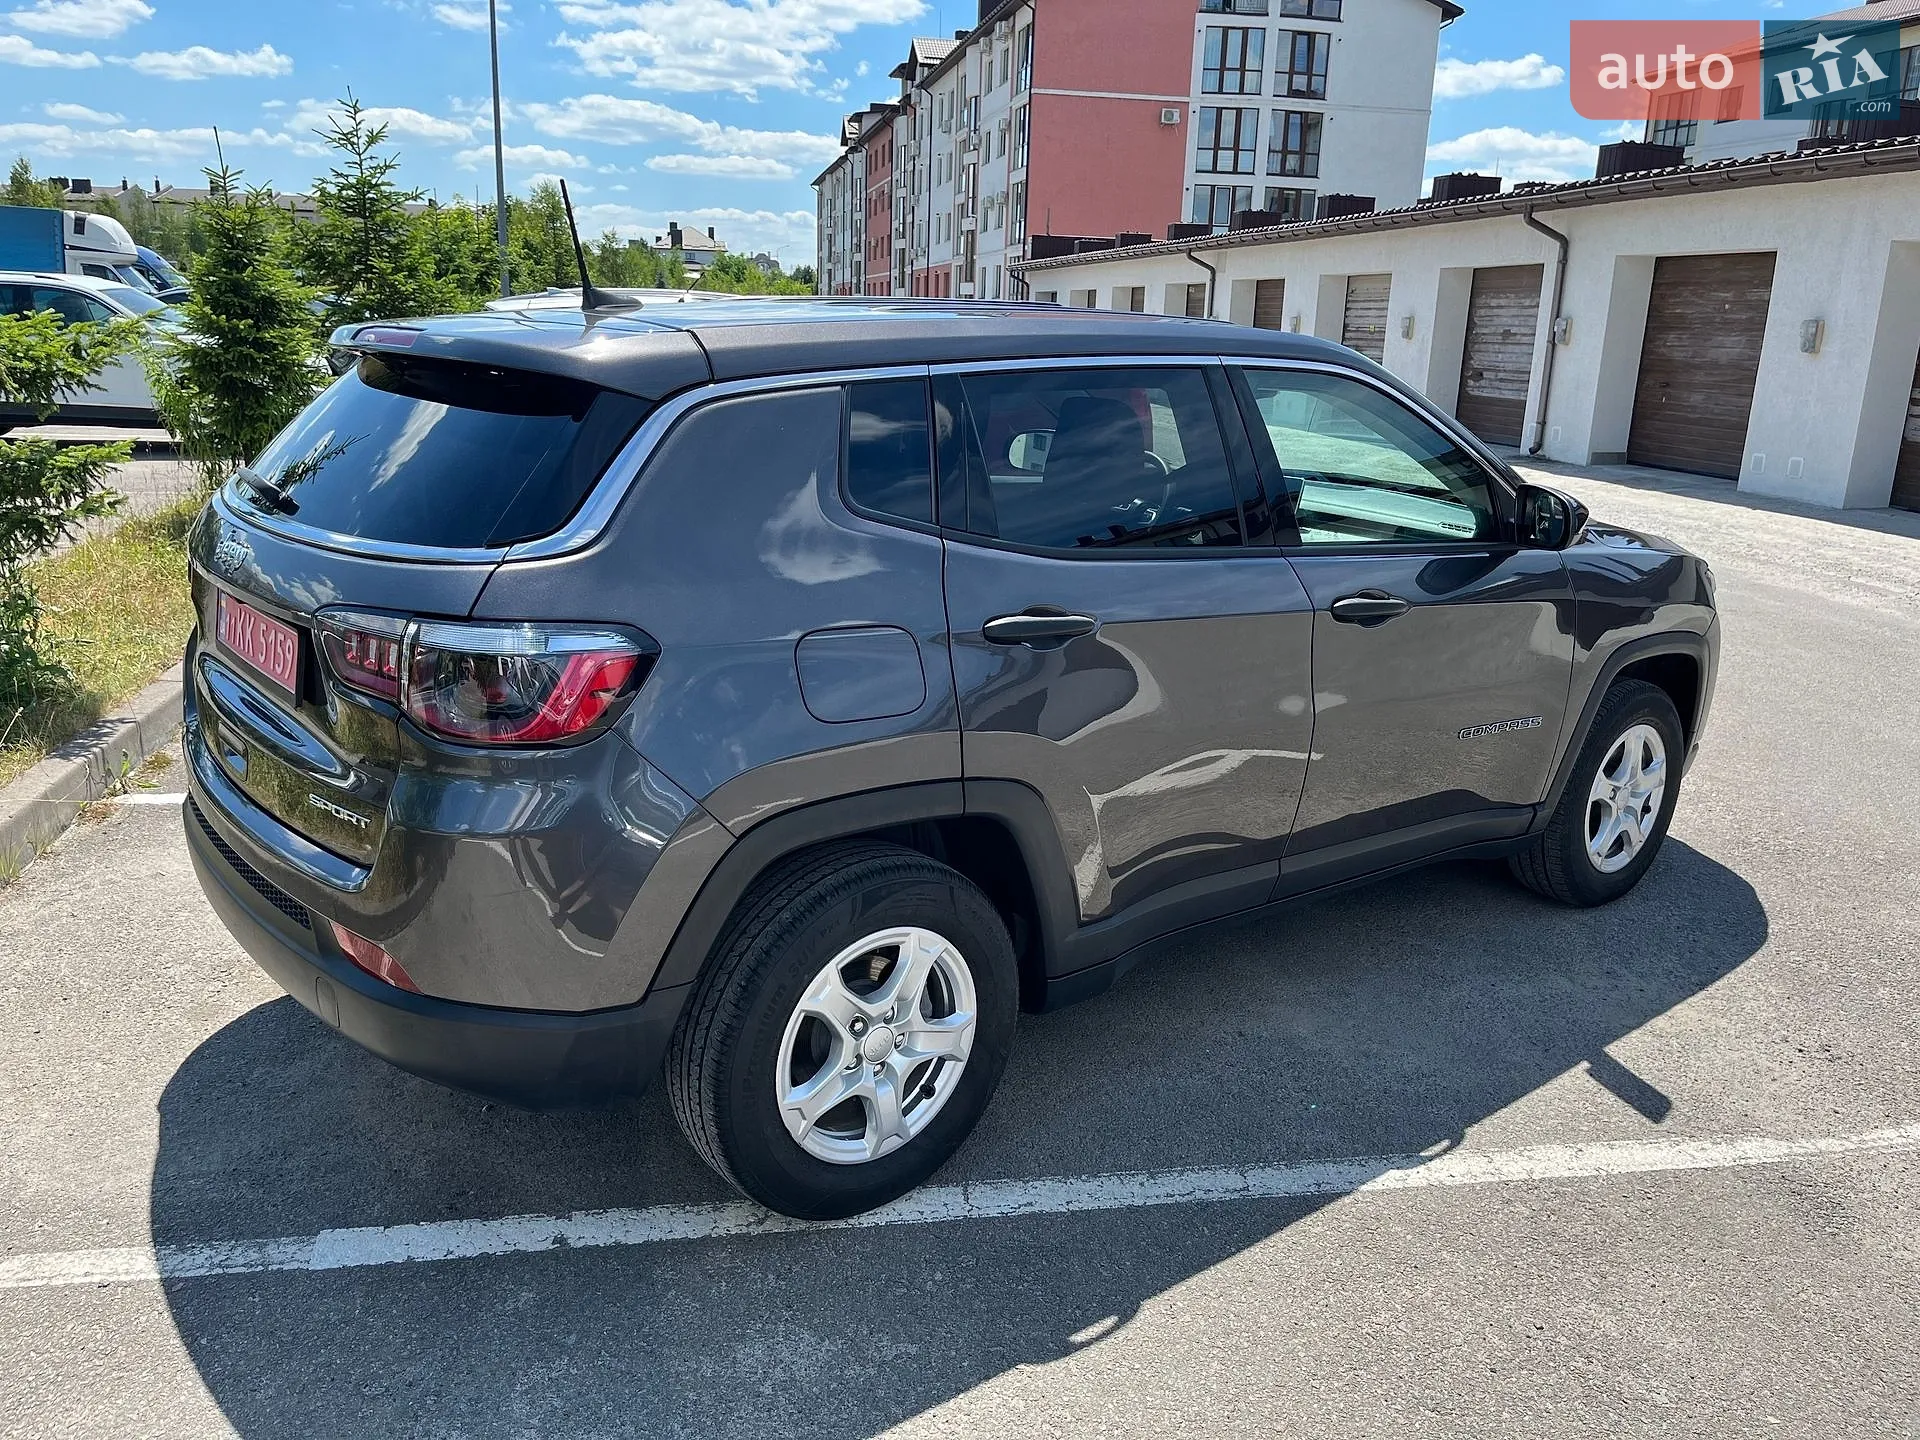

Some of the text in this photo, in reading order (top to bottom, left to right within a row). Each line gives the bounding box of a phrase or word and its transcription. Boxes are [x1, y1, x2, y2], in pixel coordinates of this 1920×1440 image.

[258, 622, 294, 680] 5159
[1459, 716, 1543, 740] COMPASS
[308, 793, 372, 829] SPORT
